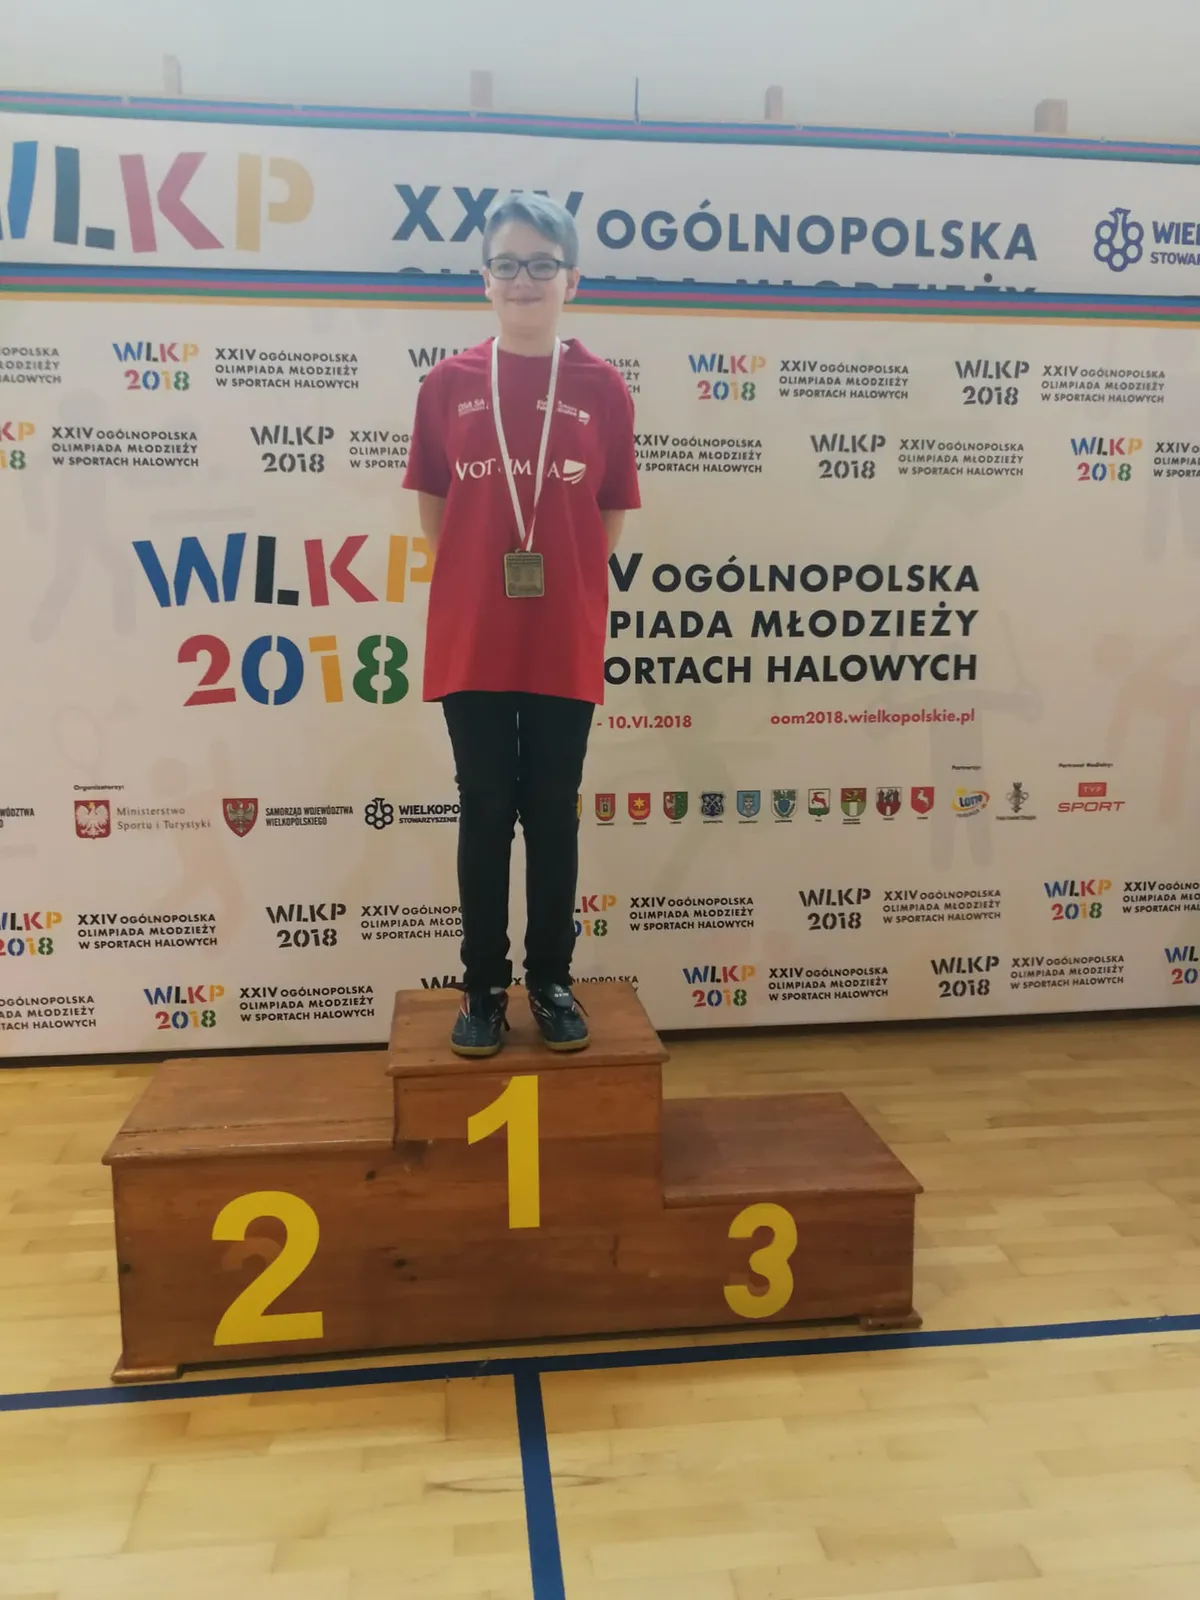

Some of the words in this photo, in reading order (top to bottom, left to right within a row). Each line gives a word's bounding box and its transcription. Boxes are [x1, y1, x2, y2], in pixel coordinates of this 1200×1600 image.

[391, 184, 584, 242] XX
[597, 198, 1038, 262] OGÓLNOPOLSKA
[112, 341, 200, 363] WLKP
[215, 347, 256, 361] XXIV
[258, 350, 358, 363] OGÓLNOPOLSKA
[215, 364, 284, 375] OLIMPIADA
[288, 365, 358, 376] MŁODZIEŻY
[688, 353, 766, 374] WLKP
[780, 360, 818, 372] XXIV
[819, 362, 909, 375] OGÓLNOPOLSKA
[955, 359, 1030, 379] WLKP
[0, 373, 62, 384] ALOWYCH
[1042, 365, 1079, 377] XXIV
[1080, 367, 1166, 379] OGÓLNOPOLSKA
[124, 369, 191, 391] 2018
[216, 377, 228, 387] W
[231, 378, 290, 388] SPORTACH
[294, 378, 359, 389] HALOWYCH
[779, 375, 841, 386] OLIMPIADA
[845, 376, 908, 387] MŁODZIEŻY
[1041, 380, 1101, 390] OLIMPIADA
[1104, 381, 1165, 392] MŁODZIEŻY
[697, 379, 756, 401] 2018
[793, 388, 847, 398] SPORTACH
[850, 389, 908, 400] HALOWYCH
[962, 385, 1019, 406] 2018
[1054, 393, 1106, 403] SPORTACH
[1108, 394, 1165, 404] HALOWYCH
[51, 426, 94, 439] XXIV
[96, 429, 198, 441] OGÓLNOPOLSKA
[250, 424, 335, 446] WLKP
[350, 430, 389, 443] XXIV
[51, 443, 122, 453] OLIMPIADA
[127, 443, 198, 454] MŁODZIEŻY
[671, 437, 762, 449] OGÓLNOPOLSKA
[810, 433, 886, 453] WLKP
[900, 439, 936, 451] XXIV
[937, 441, 1024, 452] OGÓLNOPOLSKA
[1070, 436, 1143, 456] WLKP
[1155, 441, 1191, 453] XXIV
[52, 456, 65, 465] W
[68, 457, 129, 466] SPORTACH
[133, 457, 199, 467] HALOWYCH
[699, 449, 762, 461] MŁODZIEŻY
[898, 454, 958, 464] OLIMPIADA
[962, 454, 1024, 465] MŁODZIEŻY
[261, 452, 325, 473] 2018
[645, 462, 700, 472] SPORTACH
[702, 463, 762, 473] HALOWYCH
[455, 458, 532, 481] VOTM
[818, 459, 876, 480] 2018
[911, 467, 964, 476] SPORTACH
[966, 467, 1024, 477] HALOWYCH
[1077, 462, 1133, 482] 2018
[132, 532, 434, 607] WLKP
[651, 555, 980, 593] OGÓLNOPOLSKA
[750, 601, 980, 638] MŁODZIEŻY
[177, 634, 409, 706] 2018
[767, 654, 978, 683] HALOWYCH
[608, 714, 693, 730] 10.VI.2018
[770, 708, 976, 727] oom2018.wielkopolskie.pl
[116, 807, 186, 817] Ministerstwo
[304, 804, 354, 816] WOJEWÓDZTWA
[1057, 801, 1126, 813] SPORT
[117, 820, 152, 832] Sportu
[164, 818, 211, 831] Turystyki
[265, 816, 328, 827] WIELKOPOLSKIEGO
[1044, 879, 1112, 898] WLKP
[1124, 881, 1157, 892] XXIV
[799, 888, 871, 907] WLKP
[884, 890, 918, 901] XXIV
[920, 889, 1001, 900] OGÓLNOPOLSKA
[1123, 894, 1177, 903] OLIMPIADA
[630, 897, 666, 908] XXIV
[668, 896, 754, 907] OGÓLNOPOLSKA
[883, 903, 940, 912] OLIMPIADA
[943, 900, 1001, 910] MŁODZIEŻY
[1135, 904, 1181, 913] SPORTACH
[266, 903, 347, 924] WLKP
[361, 905, 399, 917] XXIV
[629, 910, 690, 920] OLIMPIADA
[694, 907, 754, 918] MŁODZIEŻY
[896, 913, 945, 923] SPORTACH
[948, 911, 1001, 921] HALOWYCH
[1051, 902, 1102, 921] 2018
[77, 914, 118, 926] XXIV
[119, 913, 216, 925] OGÓLNOPOLSKA
[361, 919, 425, 929] OLIMPIADA
[630, 922, 640, 931] W
[643, 921, 694, 931] SPORTACH
[698, 919, 754, 929] HALOWYCH
[807, 912, 862, 931] 2018
[77, 928, 145, 938] OLIMPIADA
[149, 925, 216, 936] MŁODZIEŻY
[276, 928, 338, 948] 2018
[376, 930, 431, 940] SPORTACH
[78, 941, 91, 950] W
[94, 940, 151, 950] SPORTACH
[154, 937, 218, 948] HALOWYCH
[931, 955, 1000, 976] WLKP
[1012, 956, 1044, 968] XXIV
[1046, 955, 1125, 967] OGÓLNOPOLSKA
[683, 965, 756, 984] WLKP
[769, 968, 803, 979] XXIV
[805, 966, 888, 978] OGÓLNOPOLSKA
[1010, 969, 1066, 979] OLIMPIADA
[1069, 965, 1125, 976] MŁODZIEŻY
[768, 981, 827, 990] OLIMPIADA
[830, 977, 888, 988] MŁODZIEŻY
[938, 979, 991, 999] 2018
[1023, 979, 1070, 989] SPORTACH
[1072, 976, 1125, 987] HALOWYCH
[144, 984, 225, 1005] WLKP
[239, 986, 278, 998] XXIV
[280, 985, 374, 997] OGÓLNOPOLSKA
[769, 993, 779, 1001] W
[782, 991, 832, 1001] SPORTACH
[835, 989, 889, 999] HALOWYCH
[239, 1000, 304, 1010] OLIMPIADA
[308, 996, 374, 1008] MŁODZIEŻY
[692, 989, 747, 1008] 2018
[27, 1005, 95, 1018] MŁODZIEŻY
[240, 1013, 252, 1022] W
[255, 1011, 310, 1021] SPORTACH
[313, 1008, 375, 1019] HALOWYCH
[33, 1018, 97, 1029] HALOWYCH
[155, 1009, 217, 1030] 2018
[467, 1075, 541, 1229] 1
[723, 1203, 798, 1319] 3
[211, 1190, 324, 1346] 2
